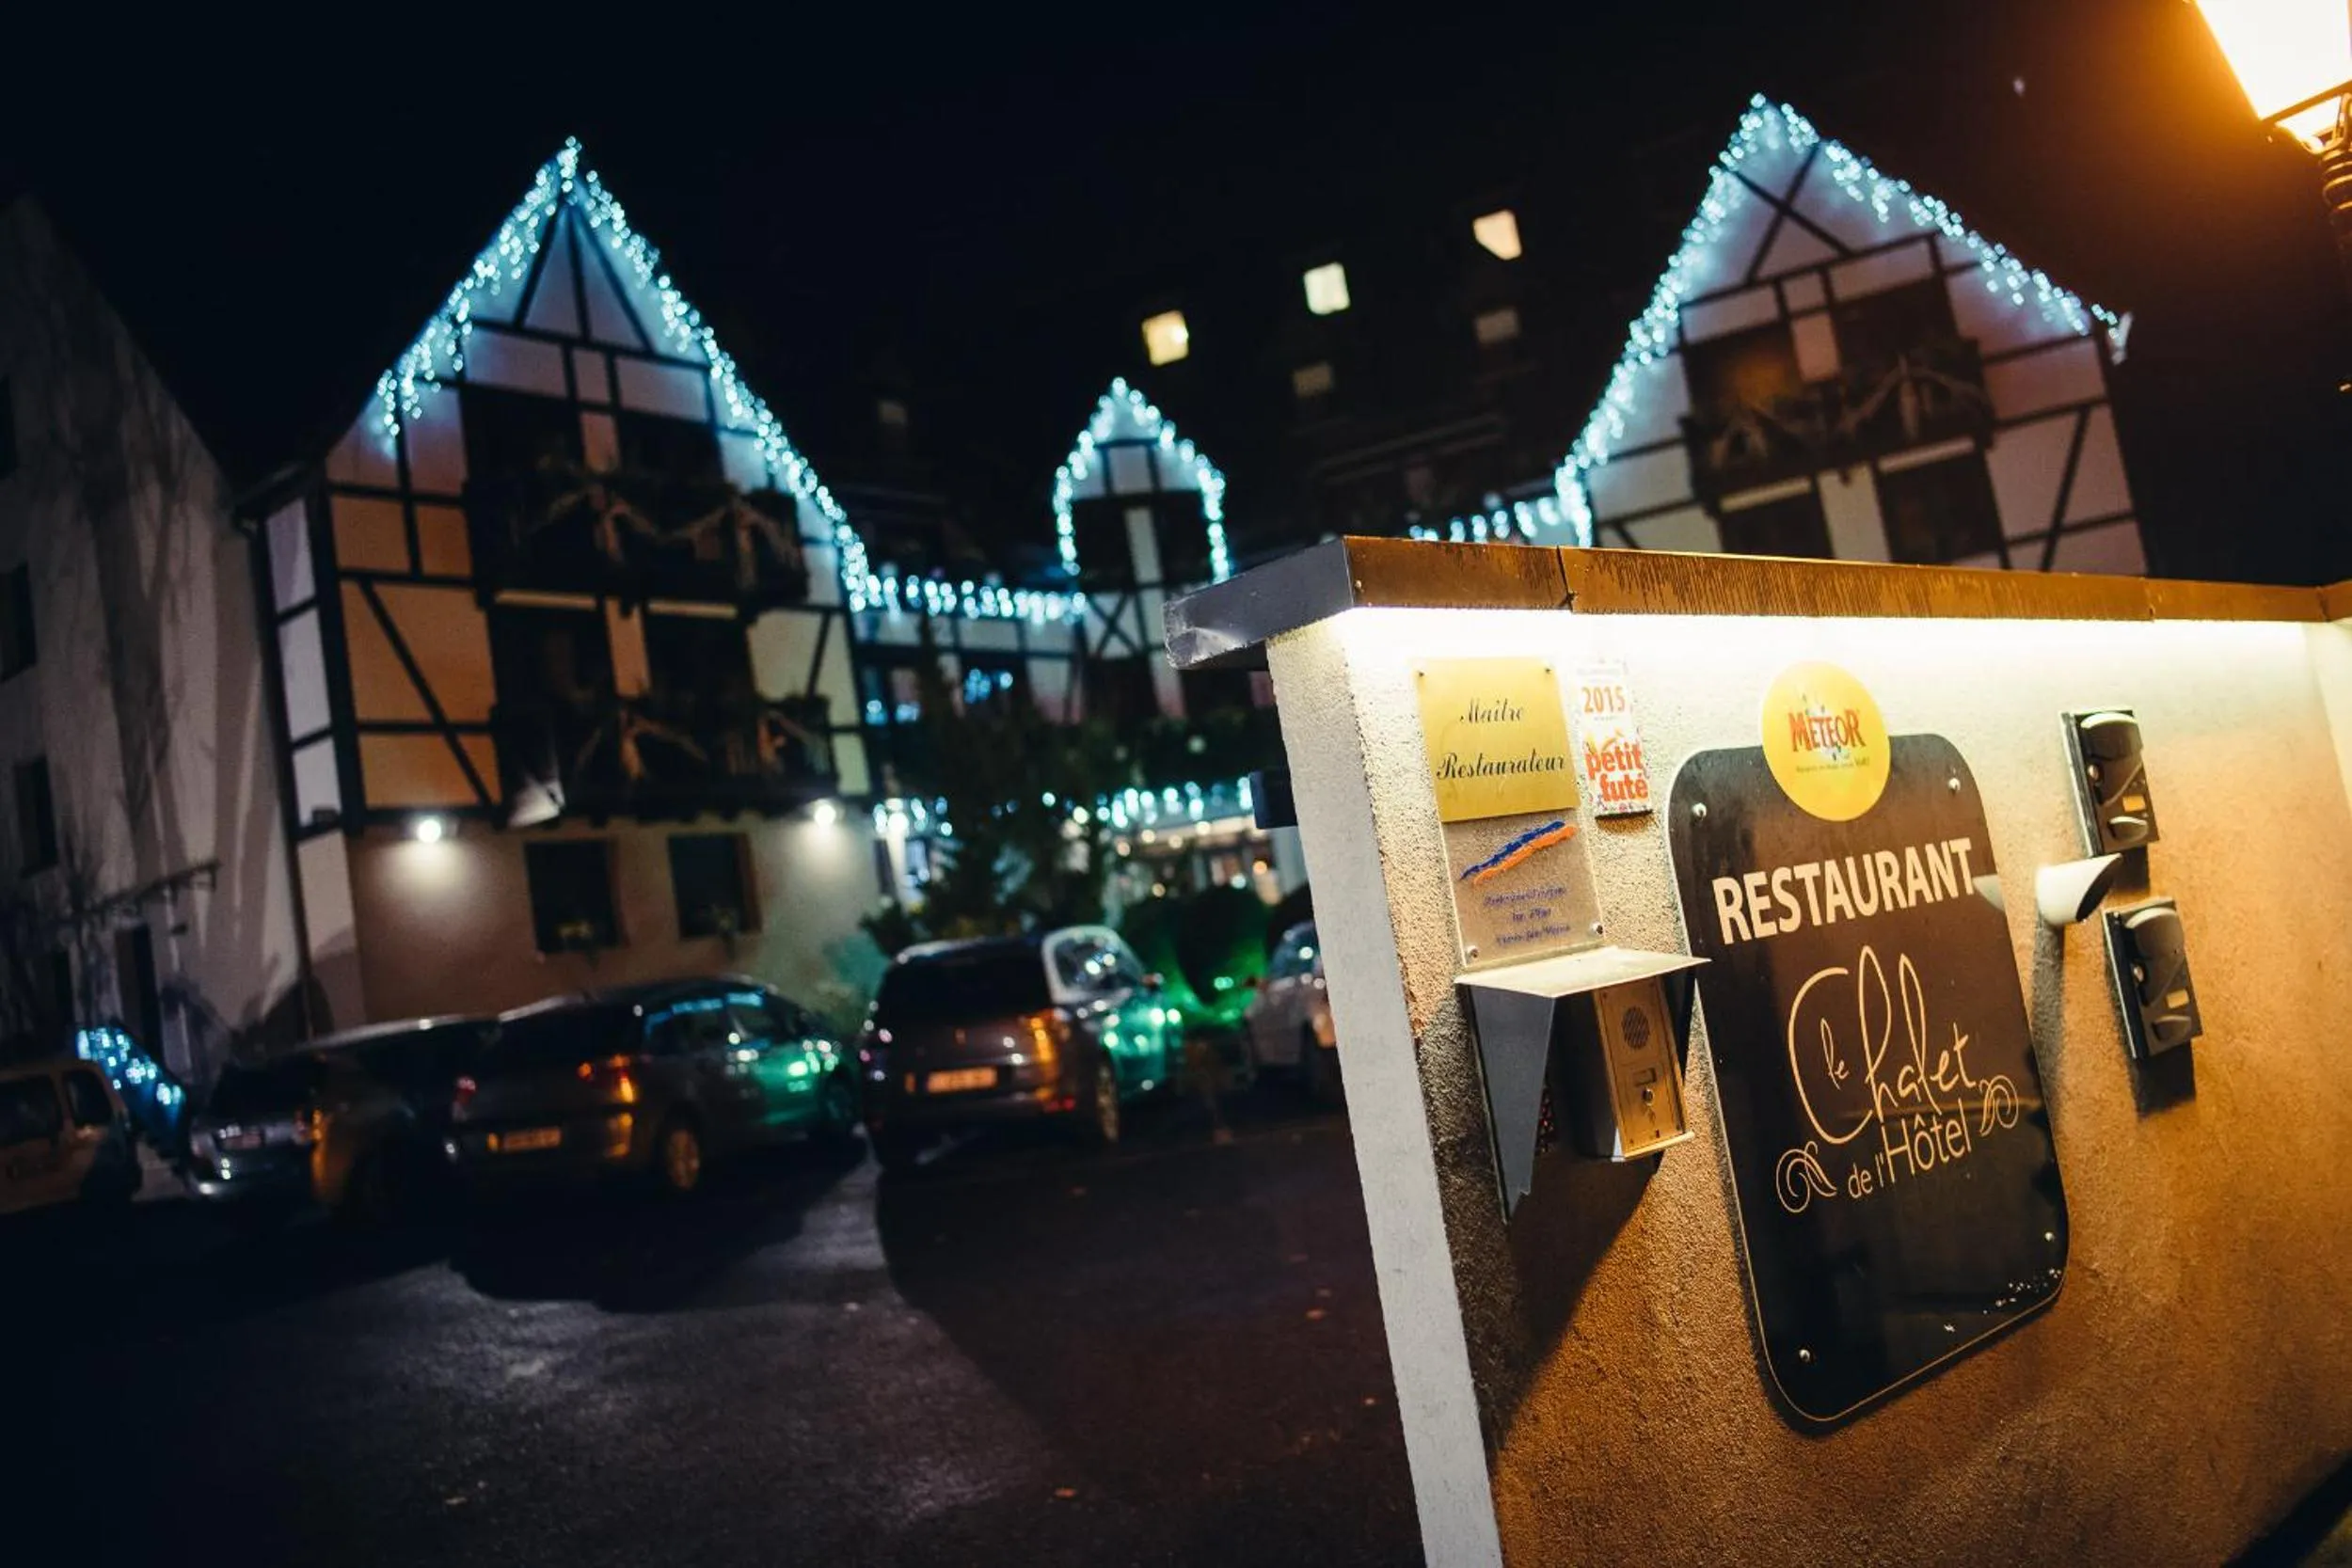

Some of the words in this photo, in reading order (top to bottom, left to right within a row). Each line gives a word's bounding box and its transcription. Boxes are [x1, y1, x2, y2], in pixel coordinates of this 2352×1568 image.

[1581, 686, 1626, 714] 2015
[1788, 709, 1867, 752] METEOR
[1437, 749, 1565, 780] Restaurateur
[1585, 743, 1644, 780] petit
[1600, 773, 1649, 801] futé
[1712, 838, 1974, 944] RESTAURANT
[1788, 944, 1976, 1145] Chalet
[1820, 1018, 1849, 1090] le
[1848, 1163, 1872, 1198] de
[1875, 1098, 1972, 1188] l'Hôtel
